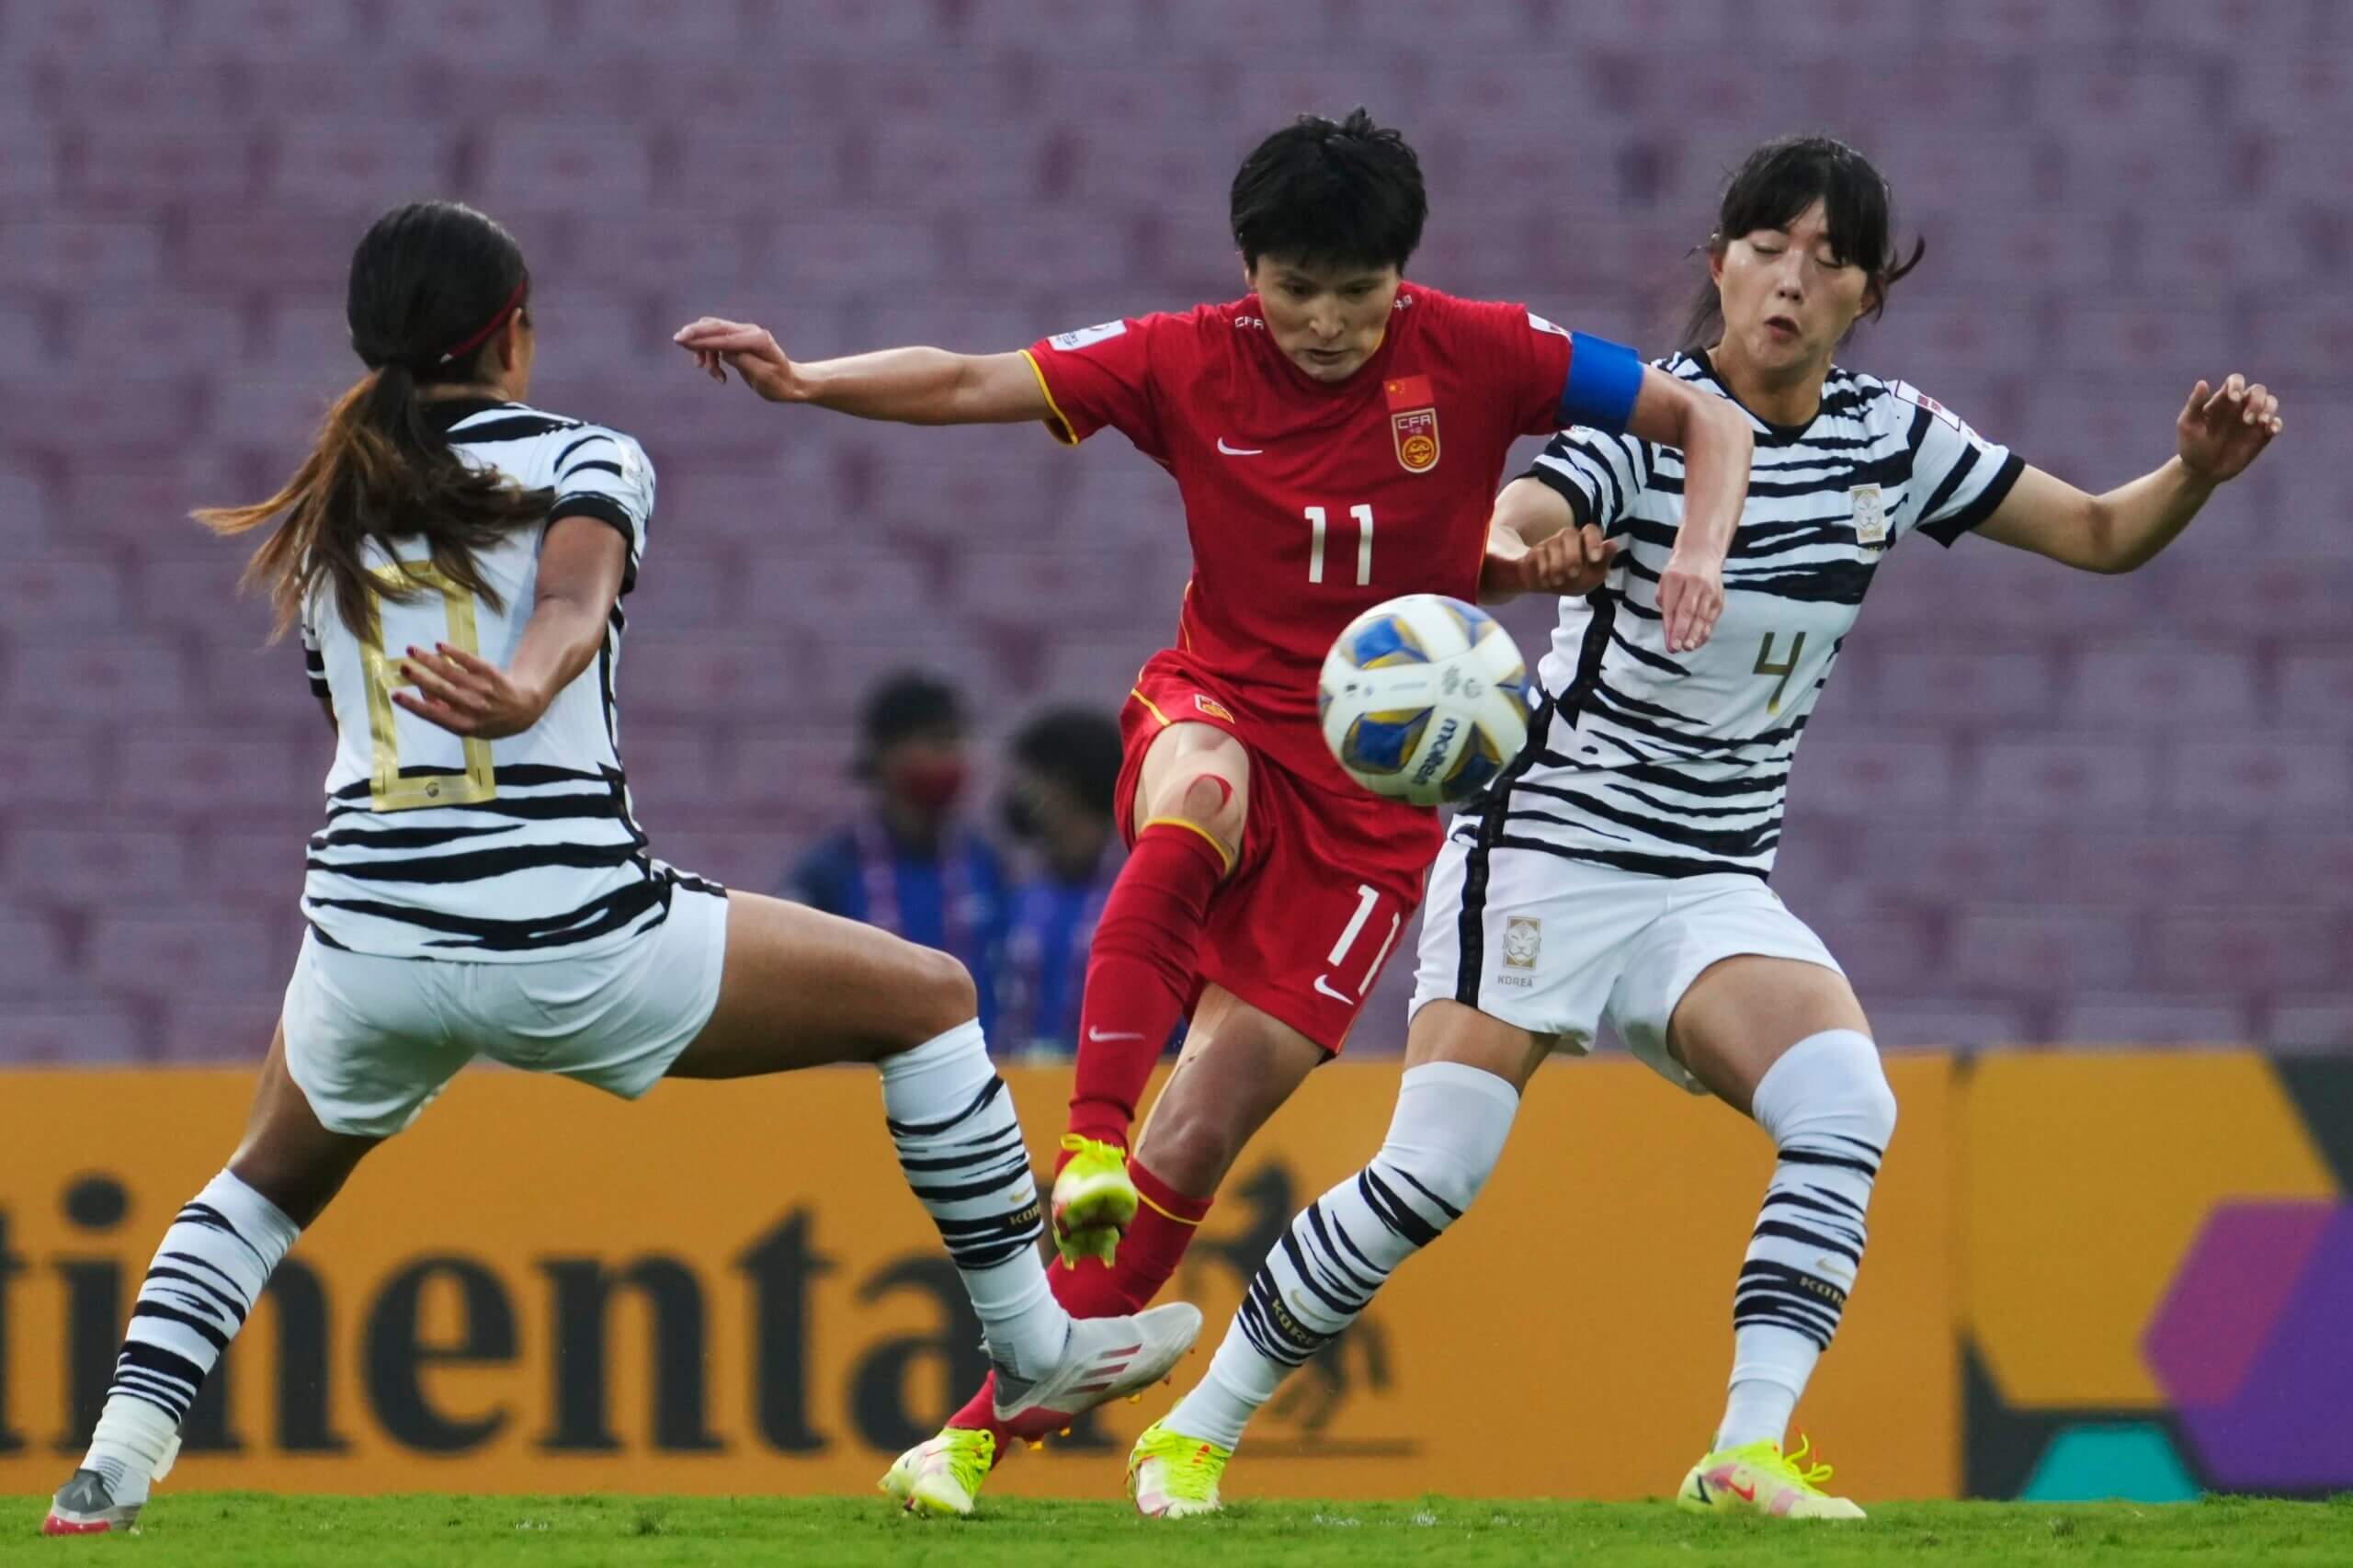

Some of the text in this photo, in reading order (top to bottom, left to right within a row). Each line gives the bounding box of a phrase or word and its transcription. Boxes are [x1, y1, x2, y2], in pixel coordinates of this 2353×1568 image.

[1397, 414, 1432, 429] CFA
[1304, 504, 1373, 585] 11
[1752, 631, 1806, 716] 4
[1327, 884, 1400, 996] 11
[1496, 974, 1534, 989] KOREA
